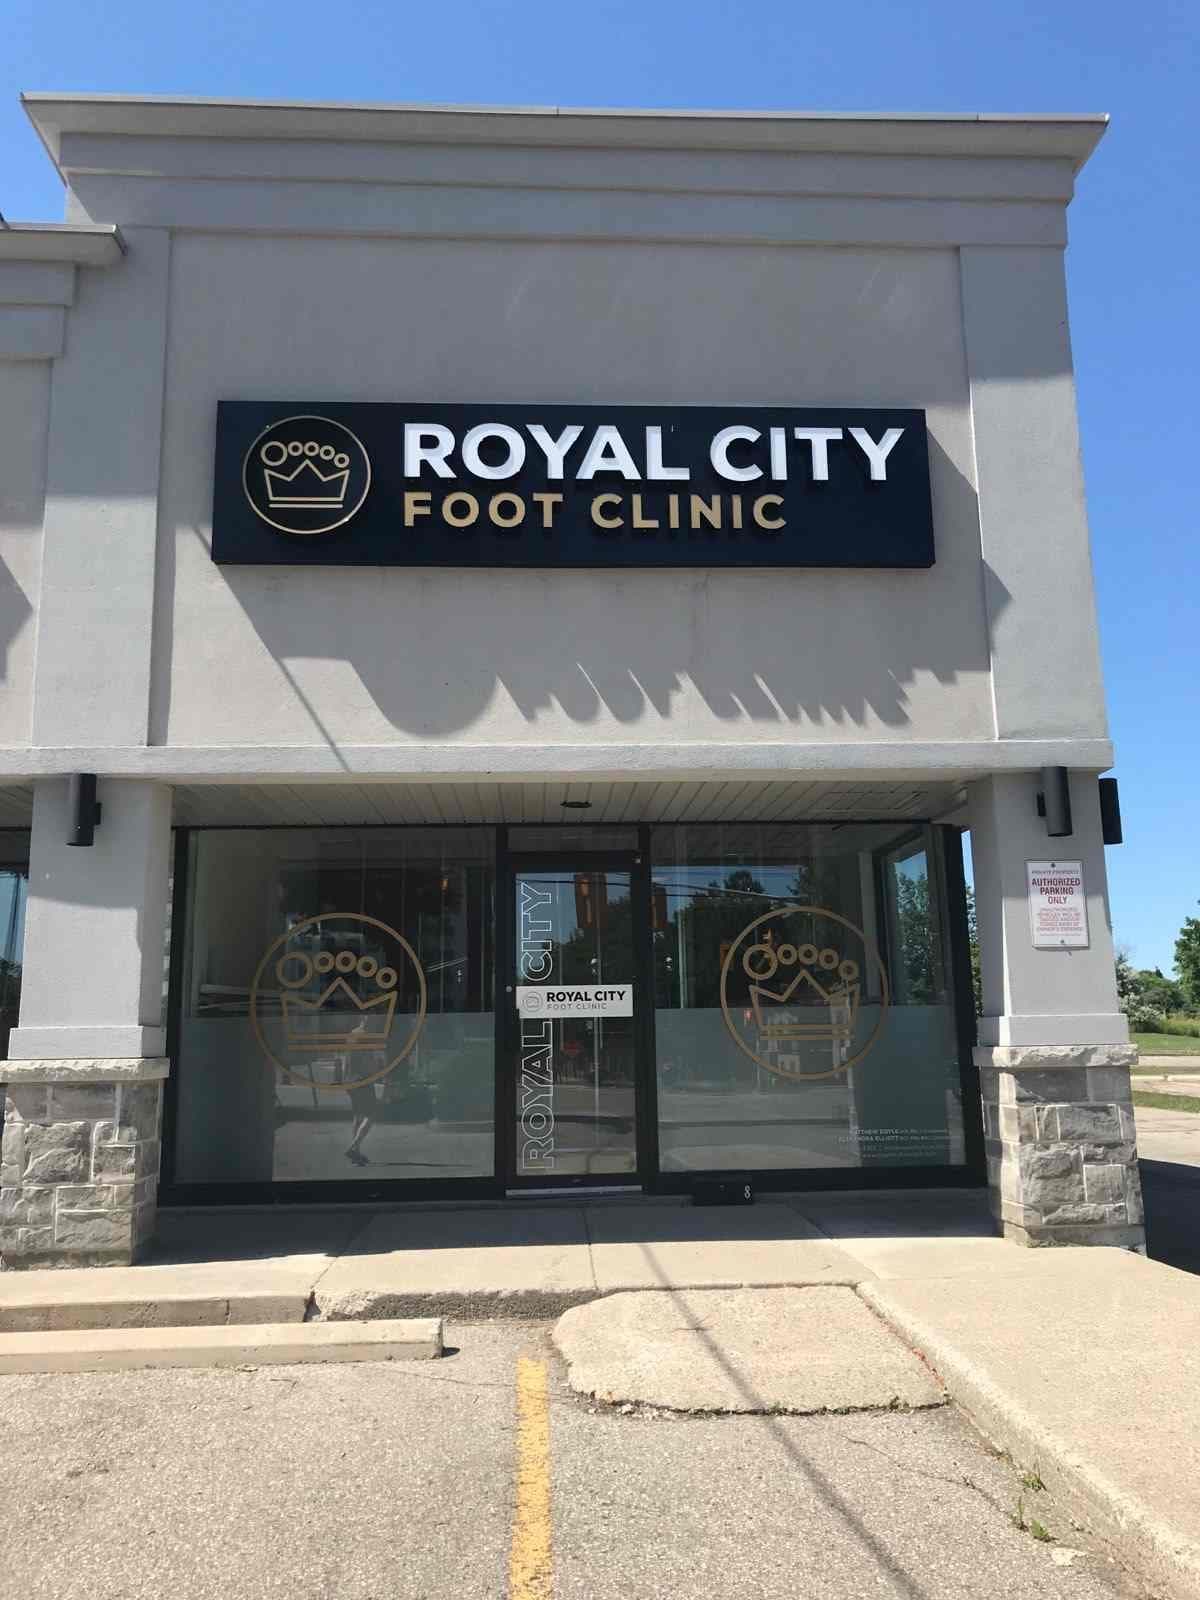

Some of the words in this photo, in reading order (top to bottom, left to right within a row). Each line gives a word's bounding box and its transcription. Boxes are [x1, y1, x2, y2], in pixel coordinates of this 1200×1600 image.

[403, 422, 690, 482] ROYAL
[710, 425, 906, 482] CITY
[403, 490, 563, 529] FOOT
[590, 492, 788, 530] CLINIC
[1032, 878, 1081, 887] AUTHORIZED
[1040, 887, 1074, 896] PARKING
[1047, 896, 1068, 904] ONLY
[520, 881, 553, 982] CITY
[546, 991, 593, 1002] ROYAL
[594, 990, 626, 1001] CITY
[576, 1002, 607, 1010] CLINIC
[521, 1020, 555, 1170] ROYAL
[744, 1185, 751, 1199] 8
